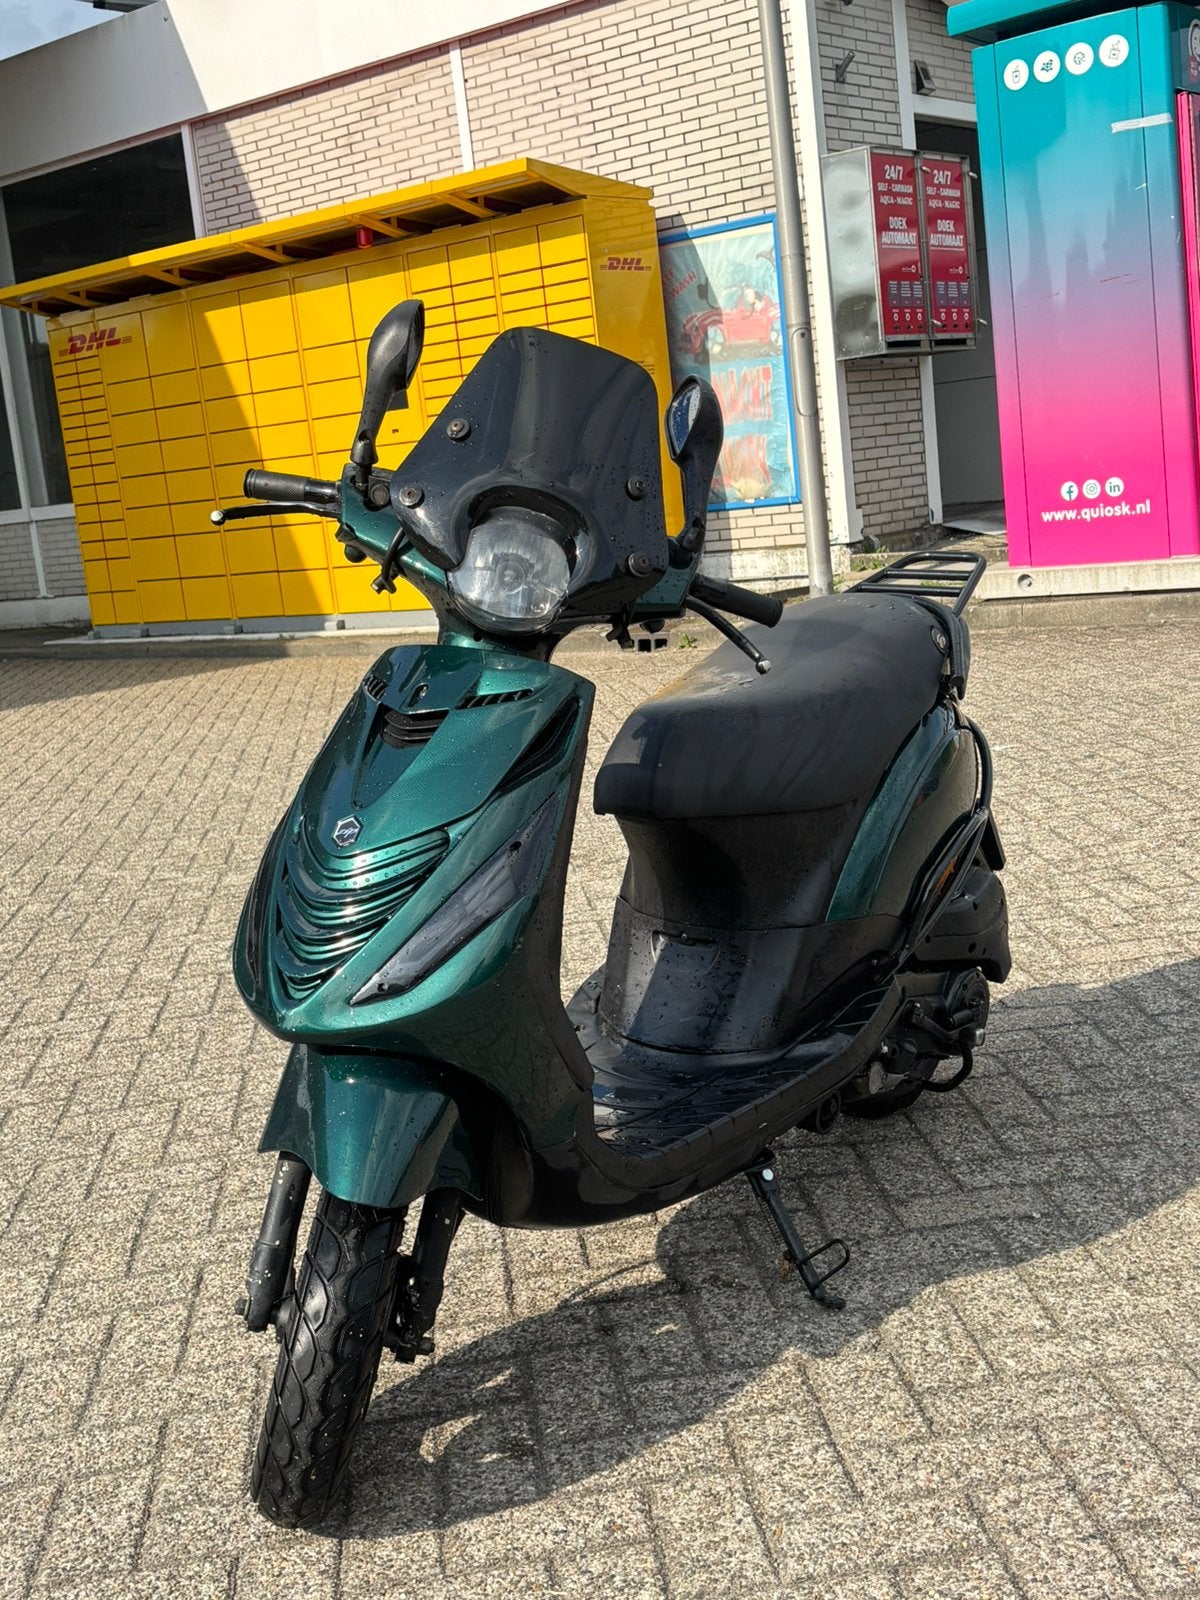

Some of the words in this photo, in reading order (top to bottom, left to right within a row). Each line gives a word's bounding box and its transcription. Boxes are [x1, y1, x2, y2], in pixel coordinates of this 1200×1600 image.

[884, 164, 903, 181] 24/7
[933, 169, 952, 185] 24/7
[877, 182, 888, 191] SELF
[926, 186, 937, 196] SELF
[888, 216, 908, 230] DOEK
[937, 219, 956, 233] DOEK
[881, 230, 917, 245] AUTOMAAT
[929, 233, 964, 247] AUTOMAAT
[607, 256, 645, 272] DHL
[670, 270, 697, 299] WASH
[67, 326, 122, 355] DHL
[1041, 499, 1151, 522] www.quiosk.nl
